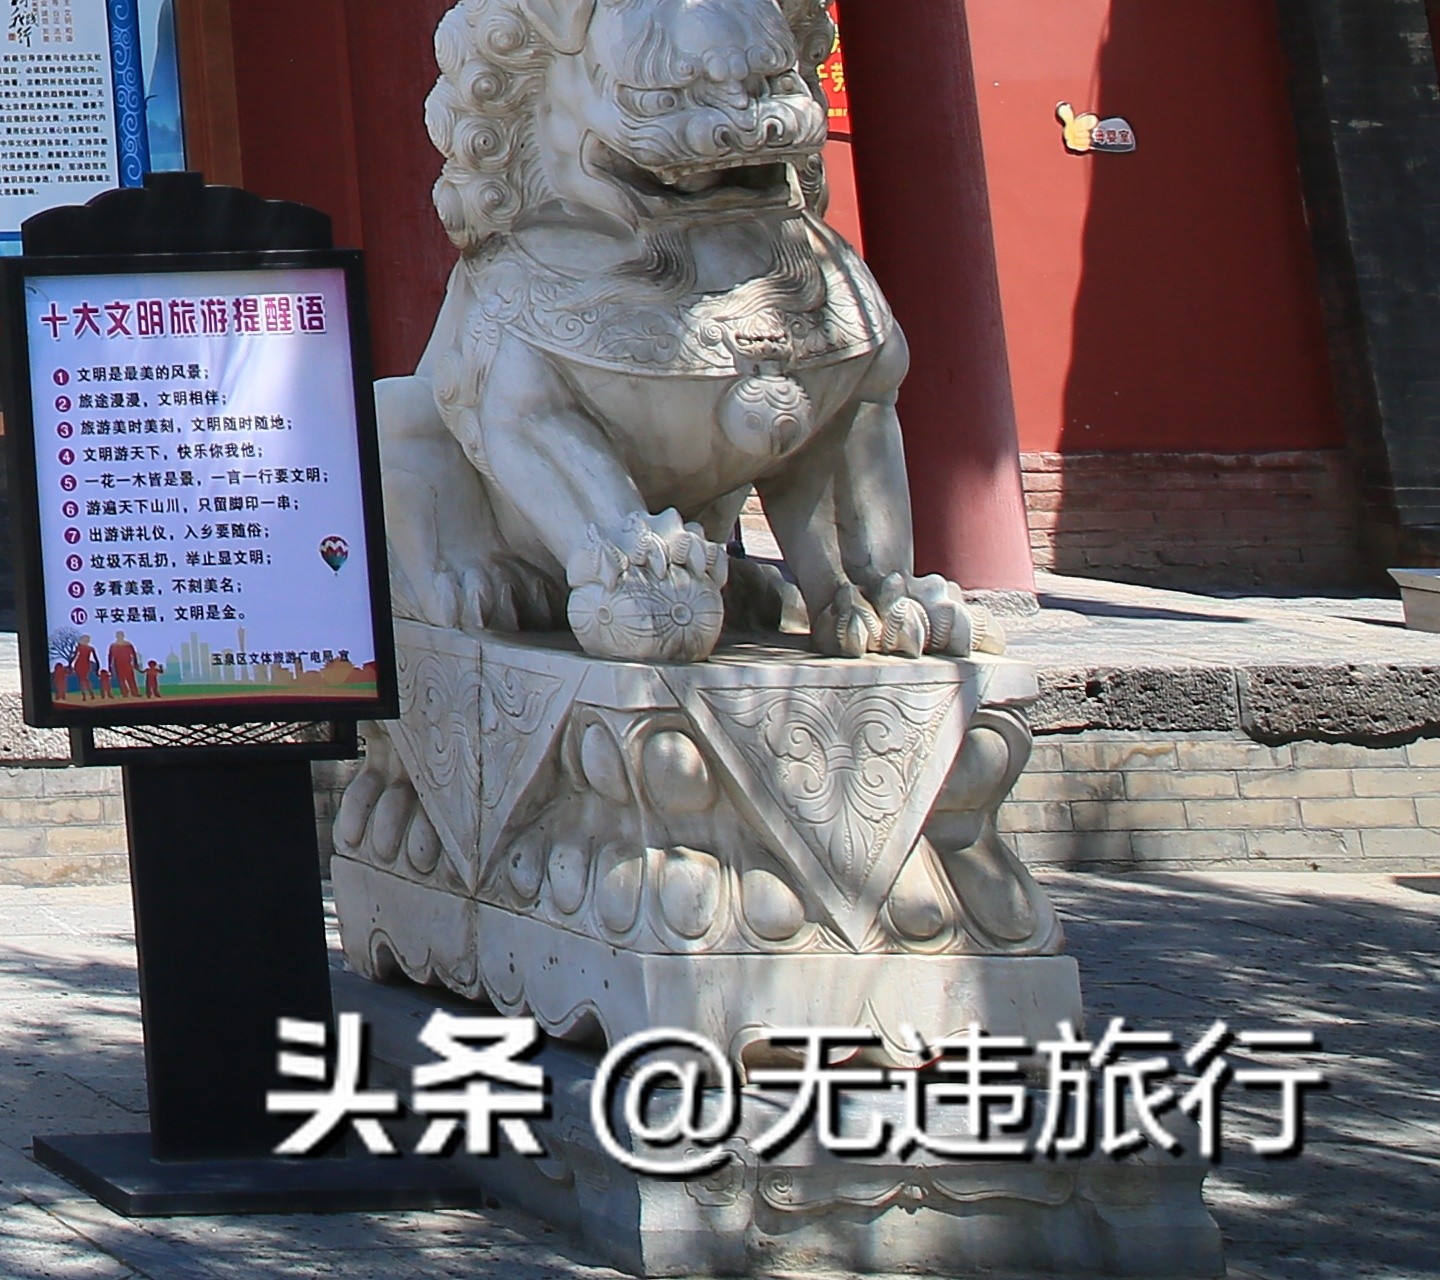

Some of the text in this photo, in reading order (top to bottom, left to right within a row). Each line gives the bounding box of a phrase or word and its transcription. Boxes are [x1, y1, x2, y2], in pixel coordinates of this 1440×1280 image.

[40, 294, 328, 339] 十大文明旅游提醒语
[77, 364, 210, 383] 文明是最美的风景；
